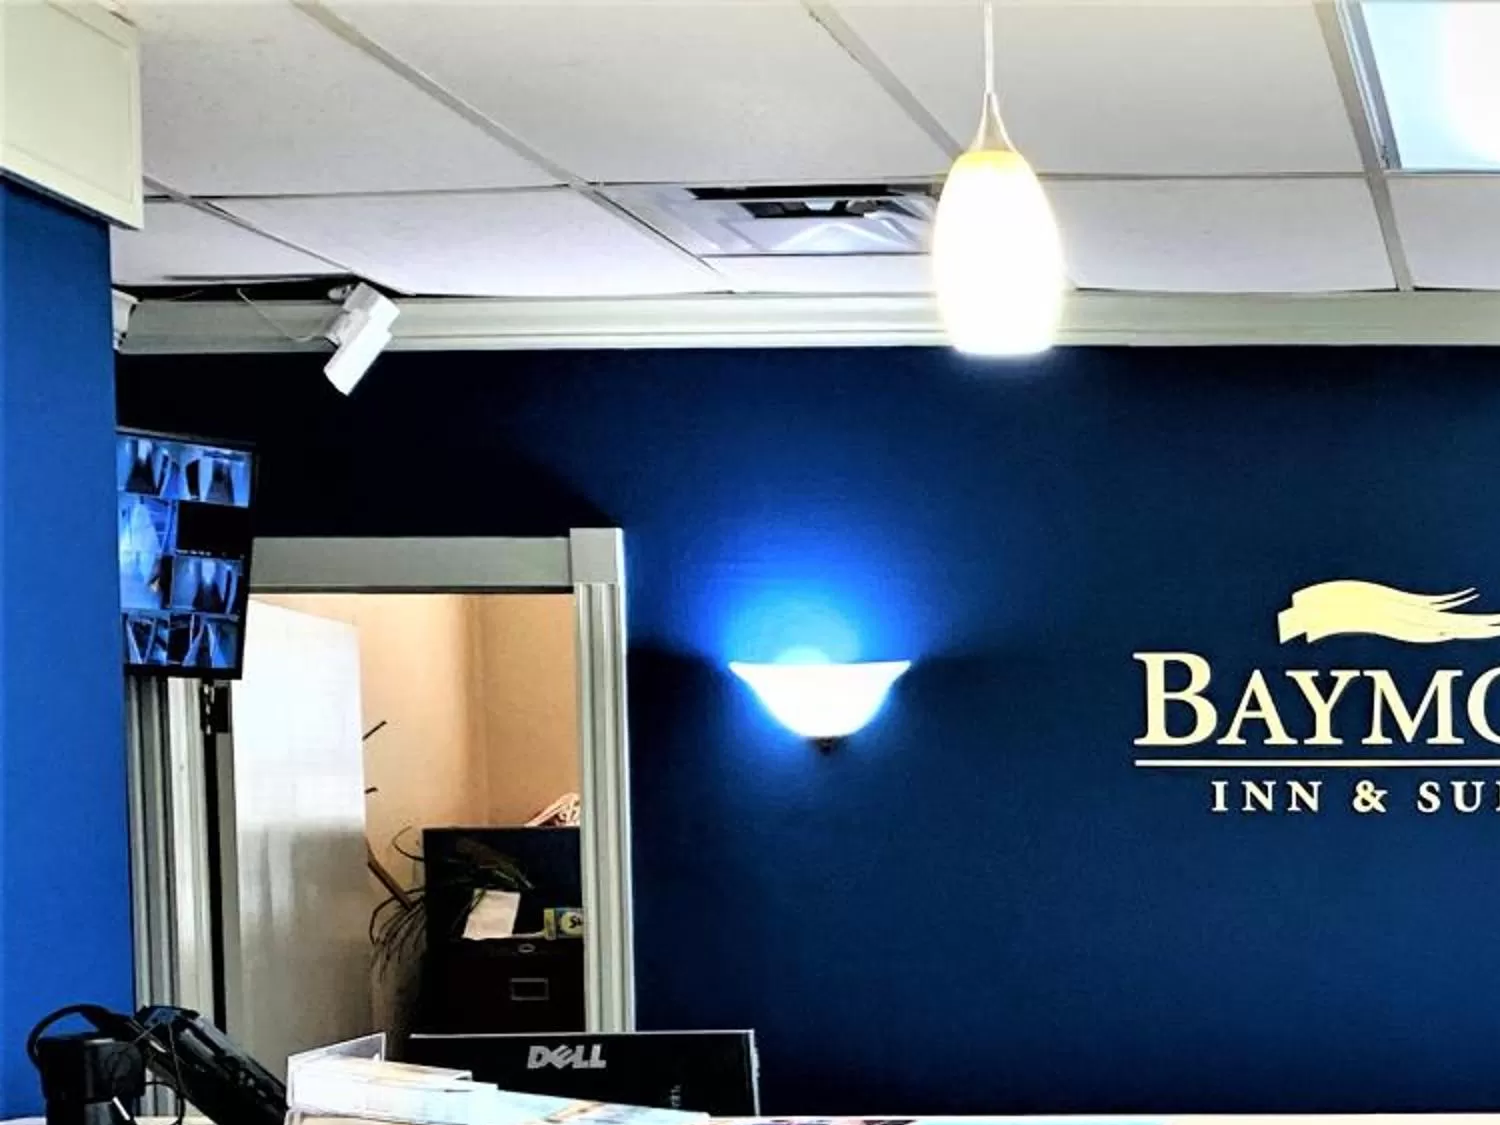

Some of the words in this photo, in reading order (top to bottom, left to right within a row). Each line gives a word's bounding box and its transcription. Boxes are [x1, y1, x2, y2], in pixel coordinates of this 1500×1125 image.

[1211, 780, 1323, 812] INN
[1352, 779, 1388, 813] &
[526, 1044, 607, 1069] DELL
